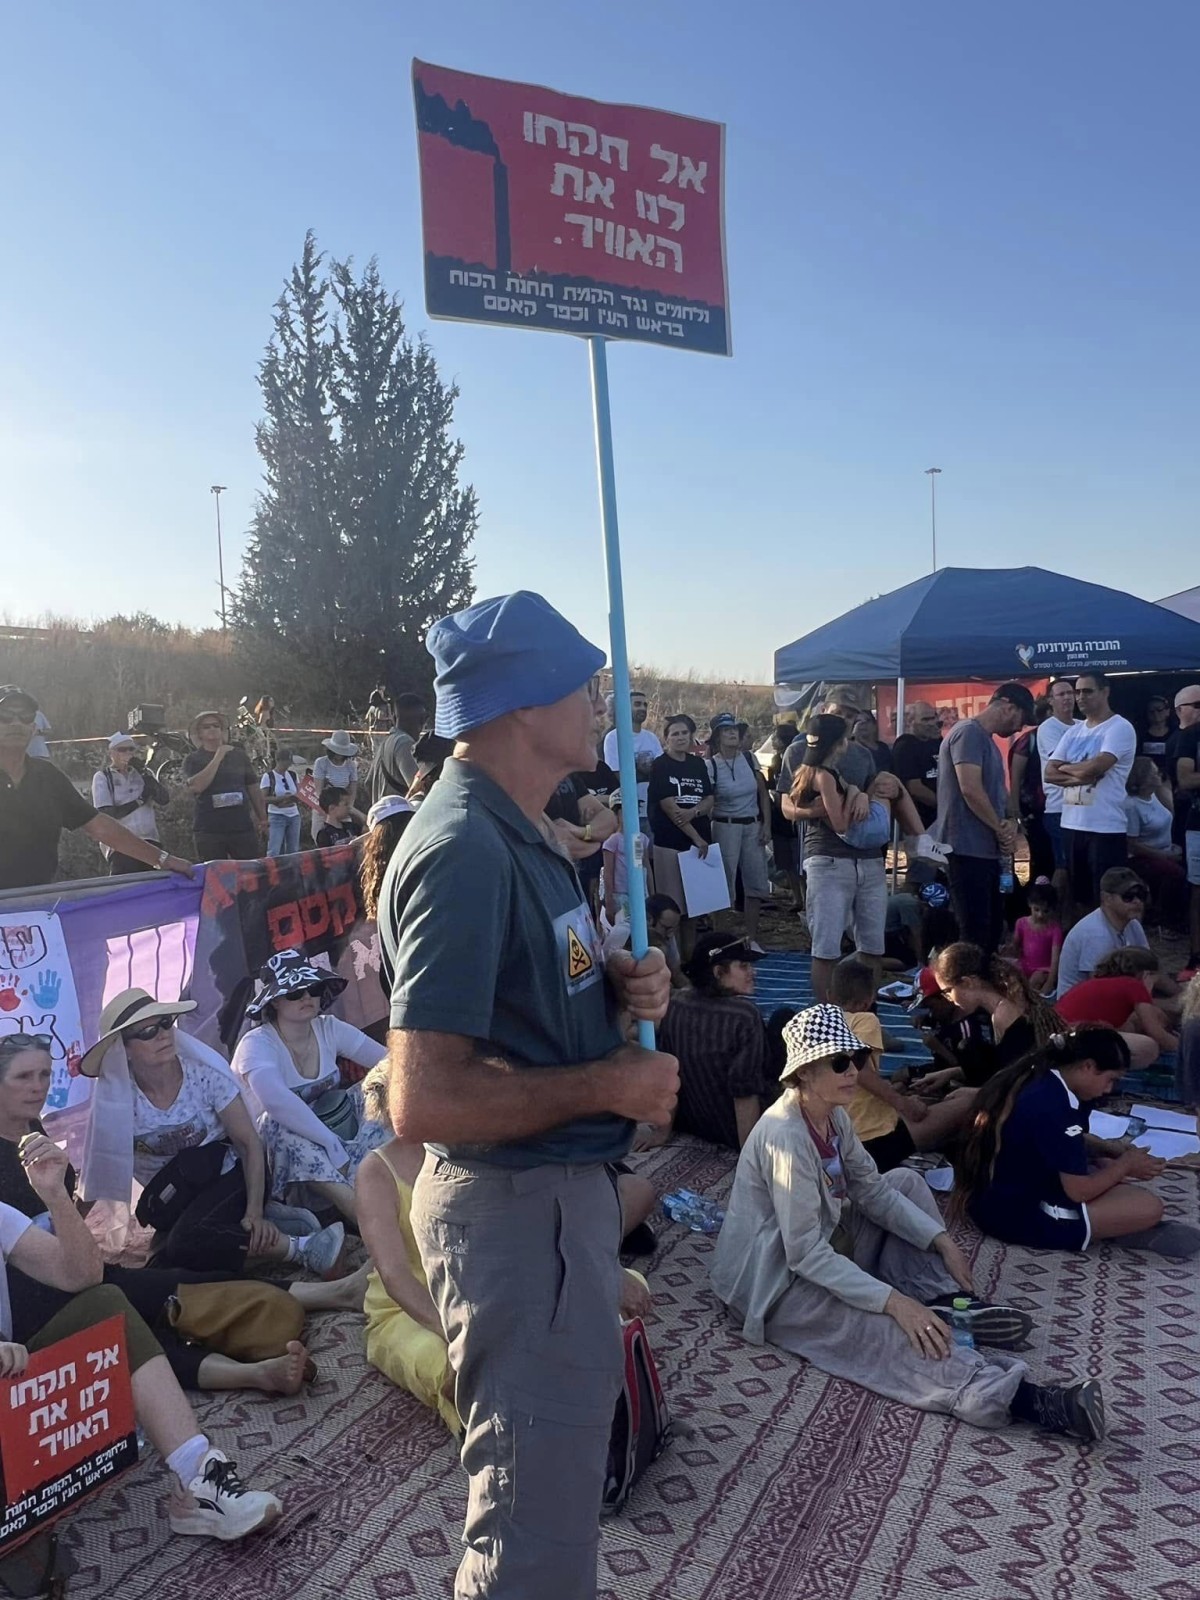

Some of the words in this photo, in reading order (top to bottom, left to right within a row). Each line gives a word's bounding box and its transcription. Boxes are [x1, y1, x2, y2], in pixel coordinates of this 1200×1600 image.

[524, 111, 629, 172] תקחו
[650, 143, 707, 193] אל
[550, 162, 615, 209] את
[636, 190, 685, 231] לנו
[450, 269, 495, 290] הכוח
[506, 278, 553, 298] תחנת
[484, 296, 536, 316] קאסם
[563, 286, 613, 305] הקמת
[622, 294, 647, 312] נגד
[546, 304, 589, 321] וכפר
[599, 309, 628, 328] העין
[655, 301, 709, 323] נלחמים
[637, 317, 684, 337] בראש
[1037, 642, 1083, 653] העירונית
[1085, 640, 1120, 651] החברה
[87, 1344, 119, 1374] אל
[11, 1362, 76, 1409] תקחו
[80, 1378, 109, 1412] לנו
[29, 1398, 67, 1435] את
[76, 1458, 91, 1477] נגד
[85, 1461, 114, 1486] בראש
[42, 1474, 72, 1500] הקמת
[62, 1481, 82, 1504] העין
[5, 1496, 37, 1520] תחנת
[32, 1496, 58, 1518] וכפר
